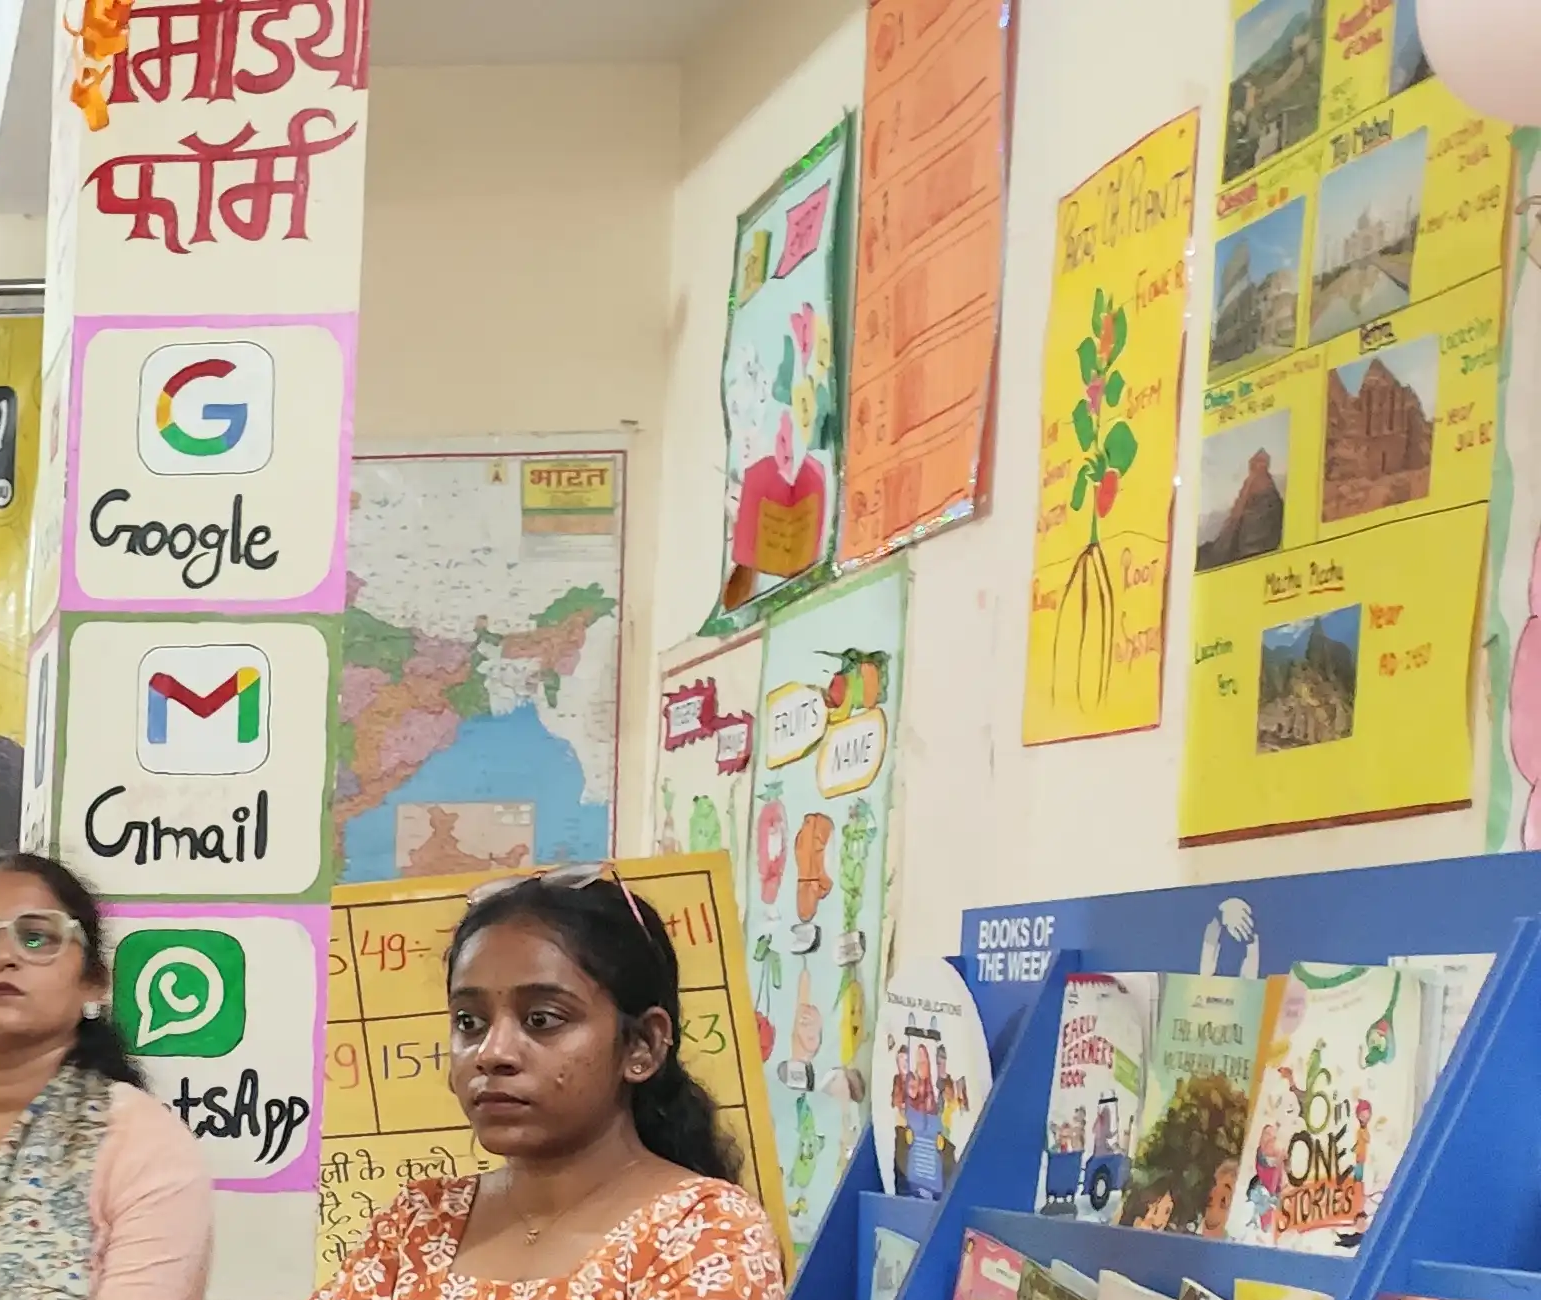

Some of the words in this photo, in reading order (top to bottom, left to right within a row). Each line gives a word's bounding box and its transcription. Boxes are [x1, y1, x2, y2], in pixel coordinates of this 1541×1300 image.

[82, 108, 358, 254] फॉर्म
[529, 467, 609, 489] भारत
[90, 488, 278, 588] Google
[773, 697, 818, 744] FRUITS
[831, 731, 874, 774] NAME
[85, 785, 268, 864] Gmail
[978, 917, 1031, 949] BOOKS
[1033, 915, 1056, 947] OF
[977, 951, 1005, 982] THE
[1007, 951, 1052, 982] WEEK
[1063, 1015, 1097, 1049] EARLY
[168, 1068, 309, 1163] tsApp
[356, 1149, 385, 1181] के
[1287, 1123, 1355, 1188] ONE
[1277, 1185, 1355, 1234] STORIES
